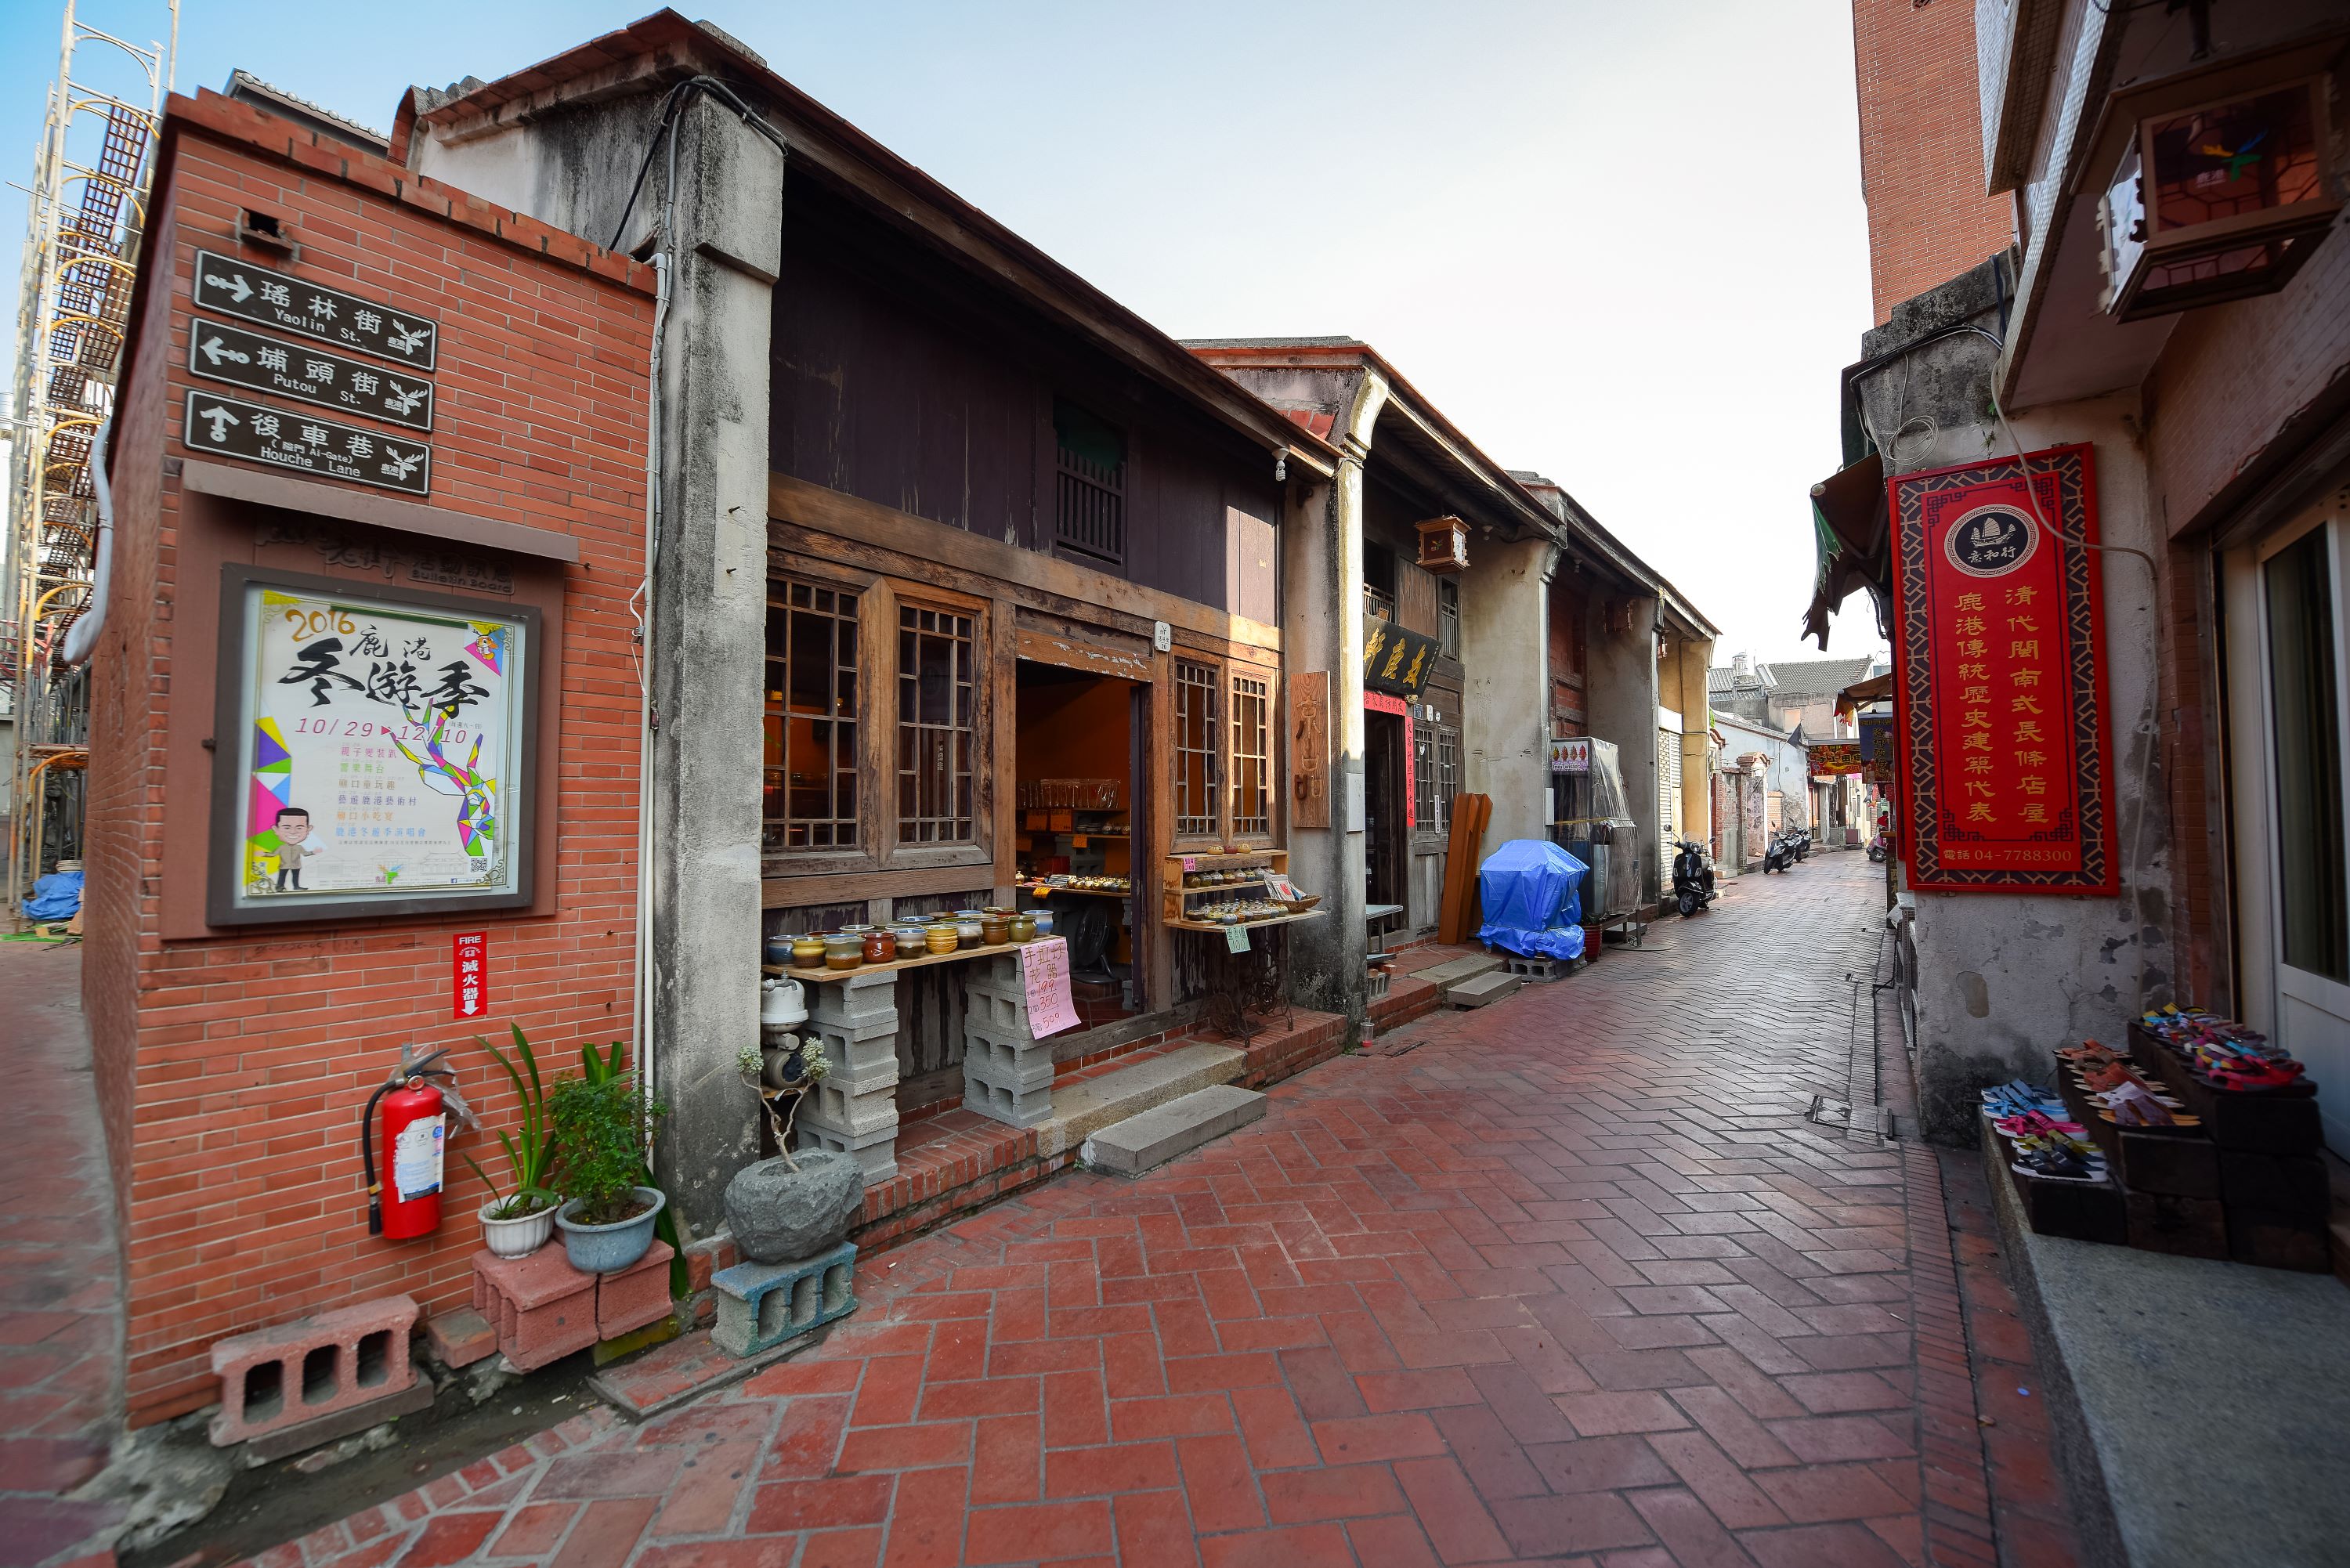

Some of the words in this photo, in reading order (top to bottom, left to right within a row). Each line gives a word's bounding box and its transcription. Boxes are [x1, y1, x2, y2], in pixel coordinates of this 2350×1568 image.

[260, 280, 381, 334] 瑤林街
[274, 308, 326, 333] Yaolin
[340, 327, 362, 343] St.
[256, 345, 380, 396] 埔頭街
[273, 374, 316, 394] Putou
[340, 390, 361, 405] St.
[250, 413, 374, 458] 後車巷
[260, 446, 313, 467] Houche
[328, 461, 361, 477] Lane
[1967, 546, 2016, 563] 意和行
[285, 609, 356, 642] 2016
[349, 624, 430, 660] 鹿港
[277, 637, 490, 719] 冬遊季
[1954, 591, 1998, 822] 鹿港傳統歷史建築代表
[2005, 585, 2049, 823] 清代閩南式長條店屋
[295, 717, 374, 737] 10/29
[396, 725, 468, 744] 12/10
[1943, 849, 1970, 861] 電話
[1974, 850, 2072, 862] 04-7788300
[458, 935, 482, 945] FIRE
[462, 959, 479, 1001] 滅火器
[1029, 963, 1058, 985] 花器
[1038, 979, 1055, 996] 199
[1039, 992, 1059, 1011] 350
[1043, 1013, 1060, 1029] 500
